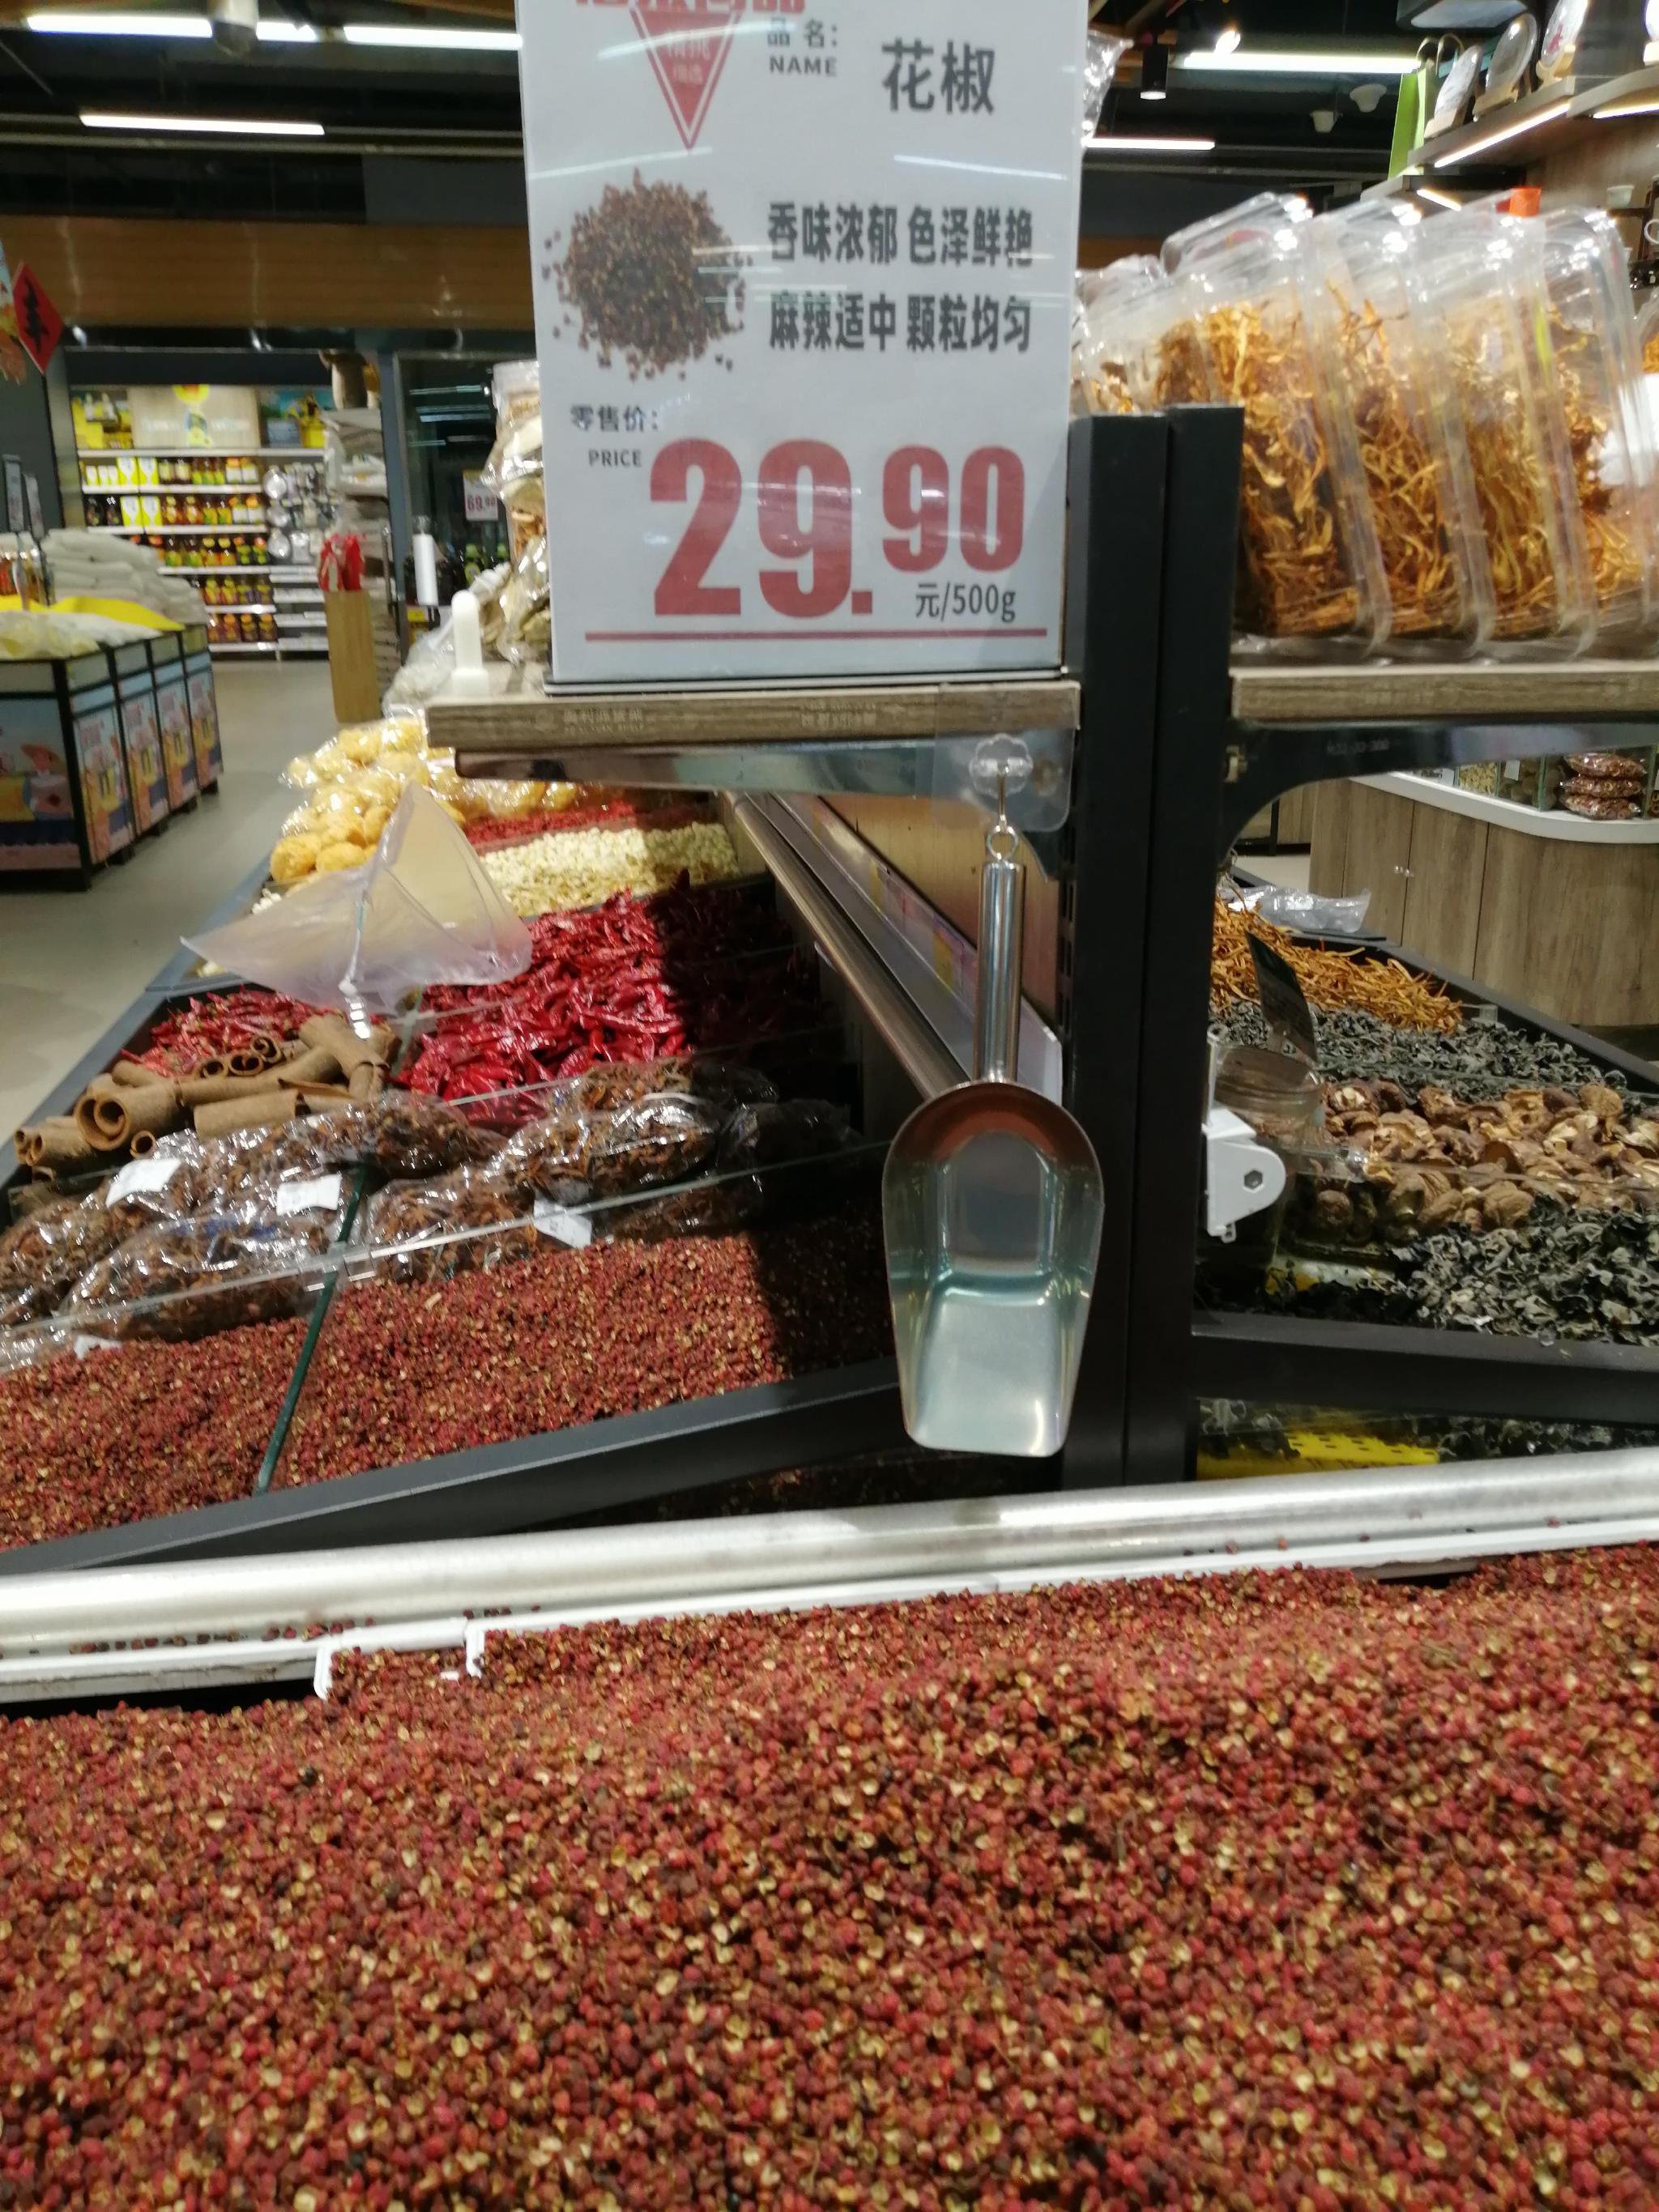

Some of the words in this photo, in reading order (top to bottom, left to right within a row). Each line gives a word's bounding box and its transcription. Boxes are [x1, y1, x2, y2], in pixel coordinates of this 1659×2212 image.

[770, 55, 838, 77] NAME
[881, 37, 995, 114] 花椒
[768, 202, 898, 263] 香味浓郁
[907, 205, 1033, 267] 色泽鲜艳
[770, 289, 897, 352] 麻辣适中
[906, 292, 1031, 353] 颗粒均匀
[588, 449, 642, 468] PRICE
[915, 581, 1017, 624] 元/500g
